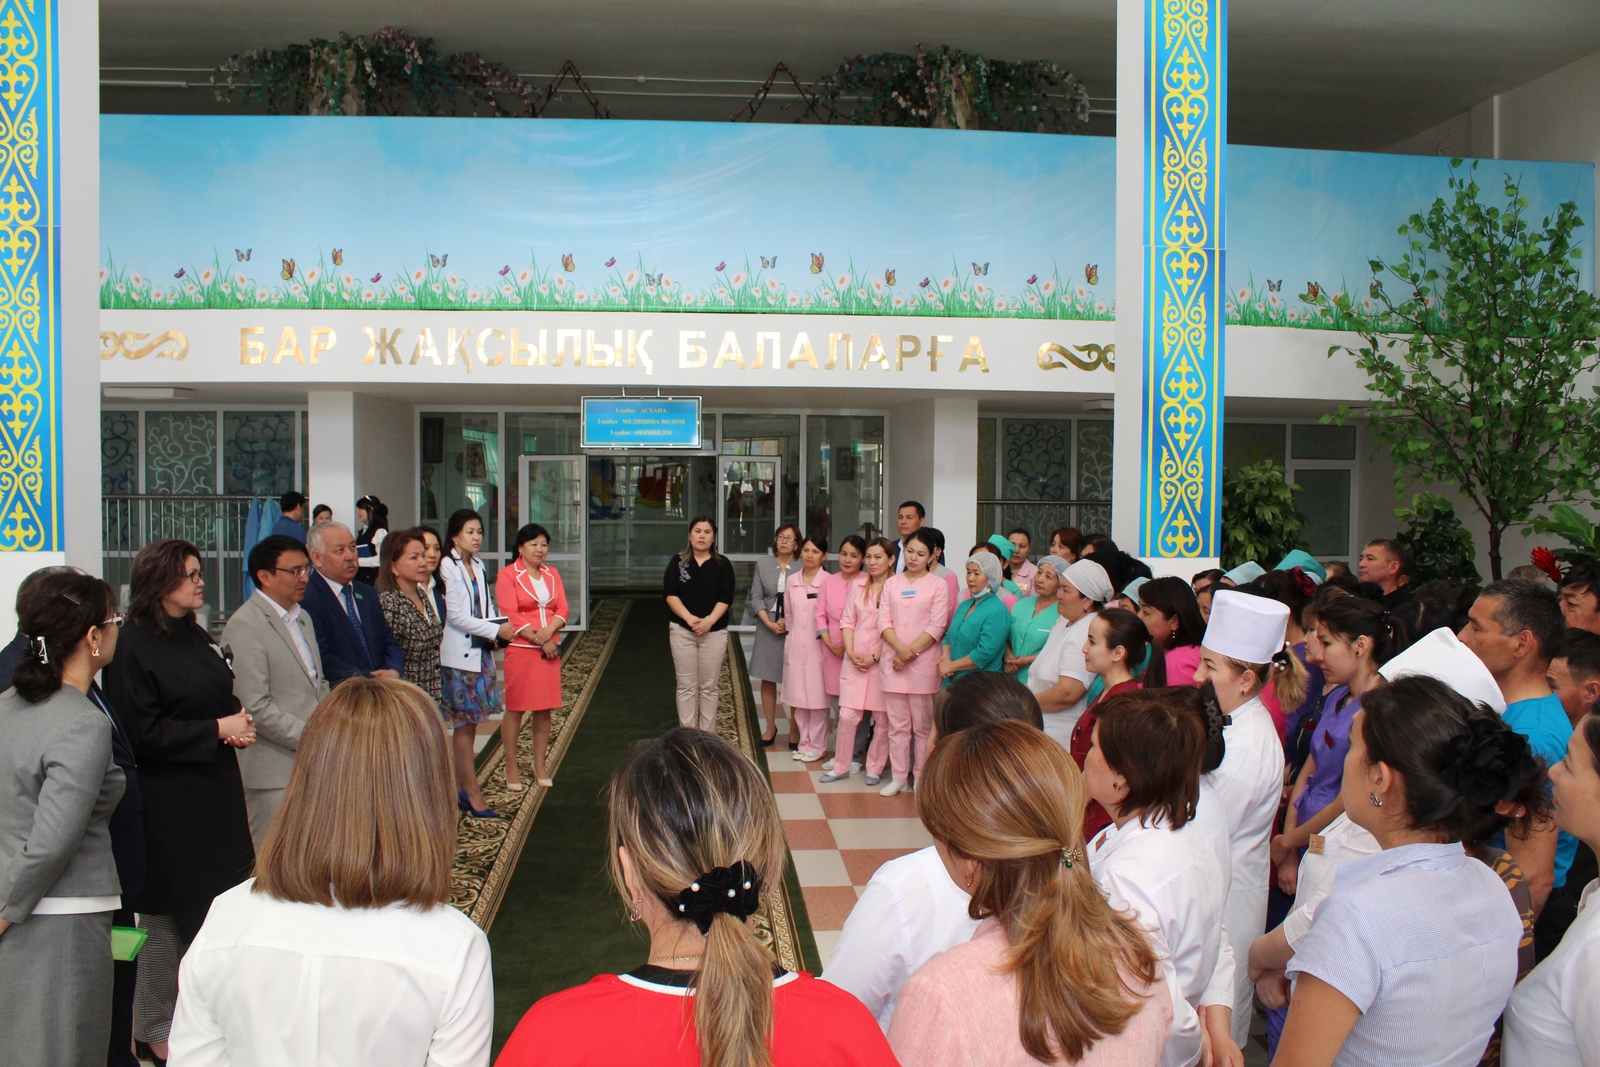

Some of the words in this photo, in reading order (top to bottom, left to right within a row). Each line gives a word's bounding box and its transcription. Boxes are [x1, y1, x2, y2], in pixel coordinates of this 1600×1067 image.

[239, 326, 337, 365] БАР
[362, 327, 653, 375] ЖАҚСЫЛЫҚ
[678, 330, 990, 374] БАЛАЛАРҒА
